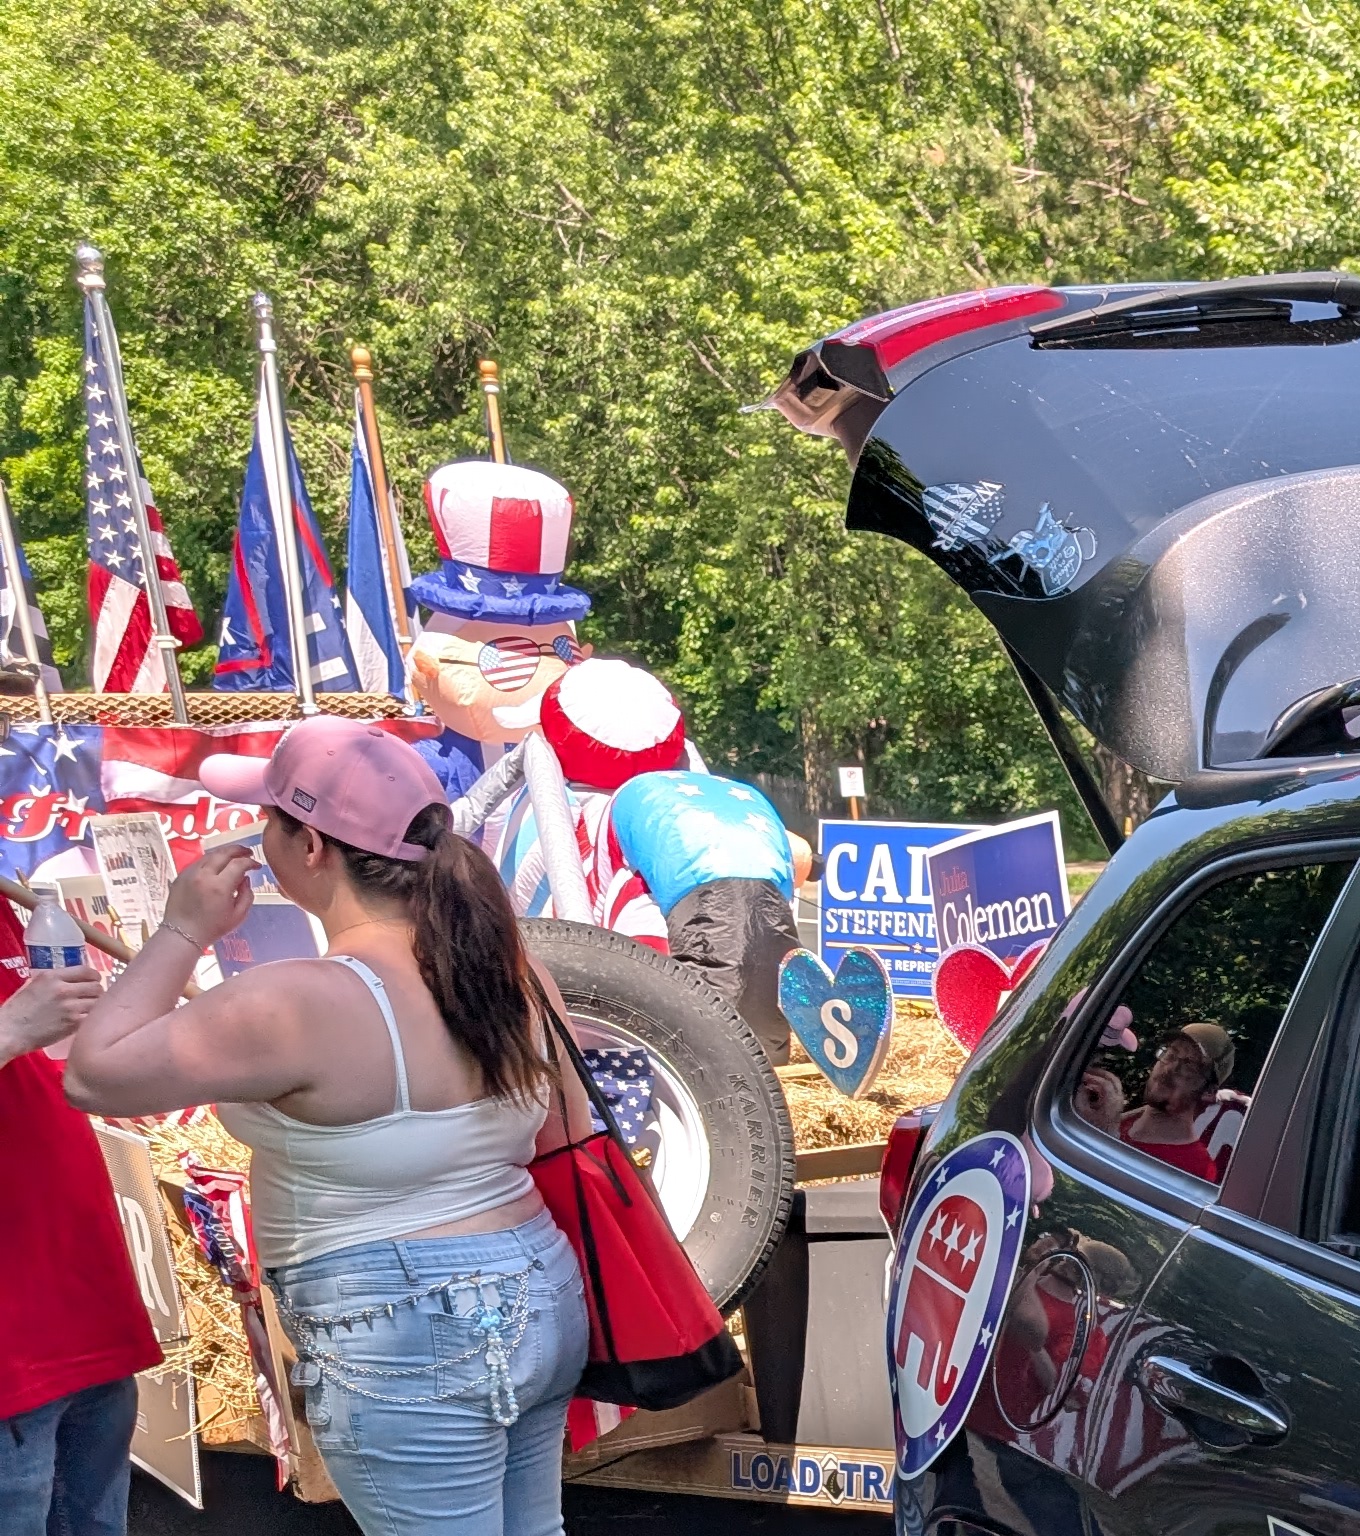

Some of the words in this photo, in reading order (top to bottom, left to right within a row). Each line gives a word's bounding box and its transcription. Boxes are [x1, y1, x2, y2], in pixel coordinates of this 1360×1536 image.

[931, 480, 1006, 551] WARRIOR
[943, 893, 1058, 950] Coleman
[821, 999, 858, 1068] S
[731, 1451, 823, 1497] LOAD
